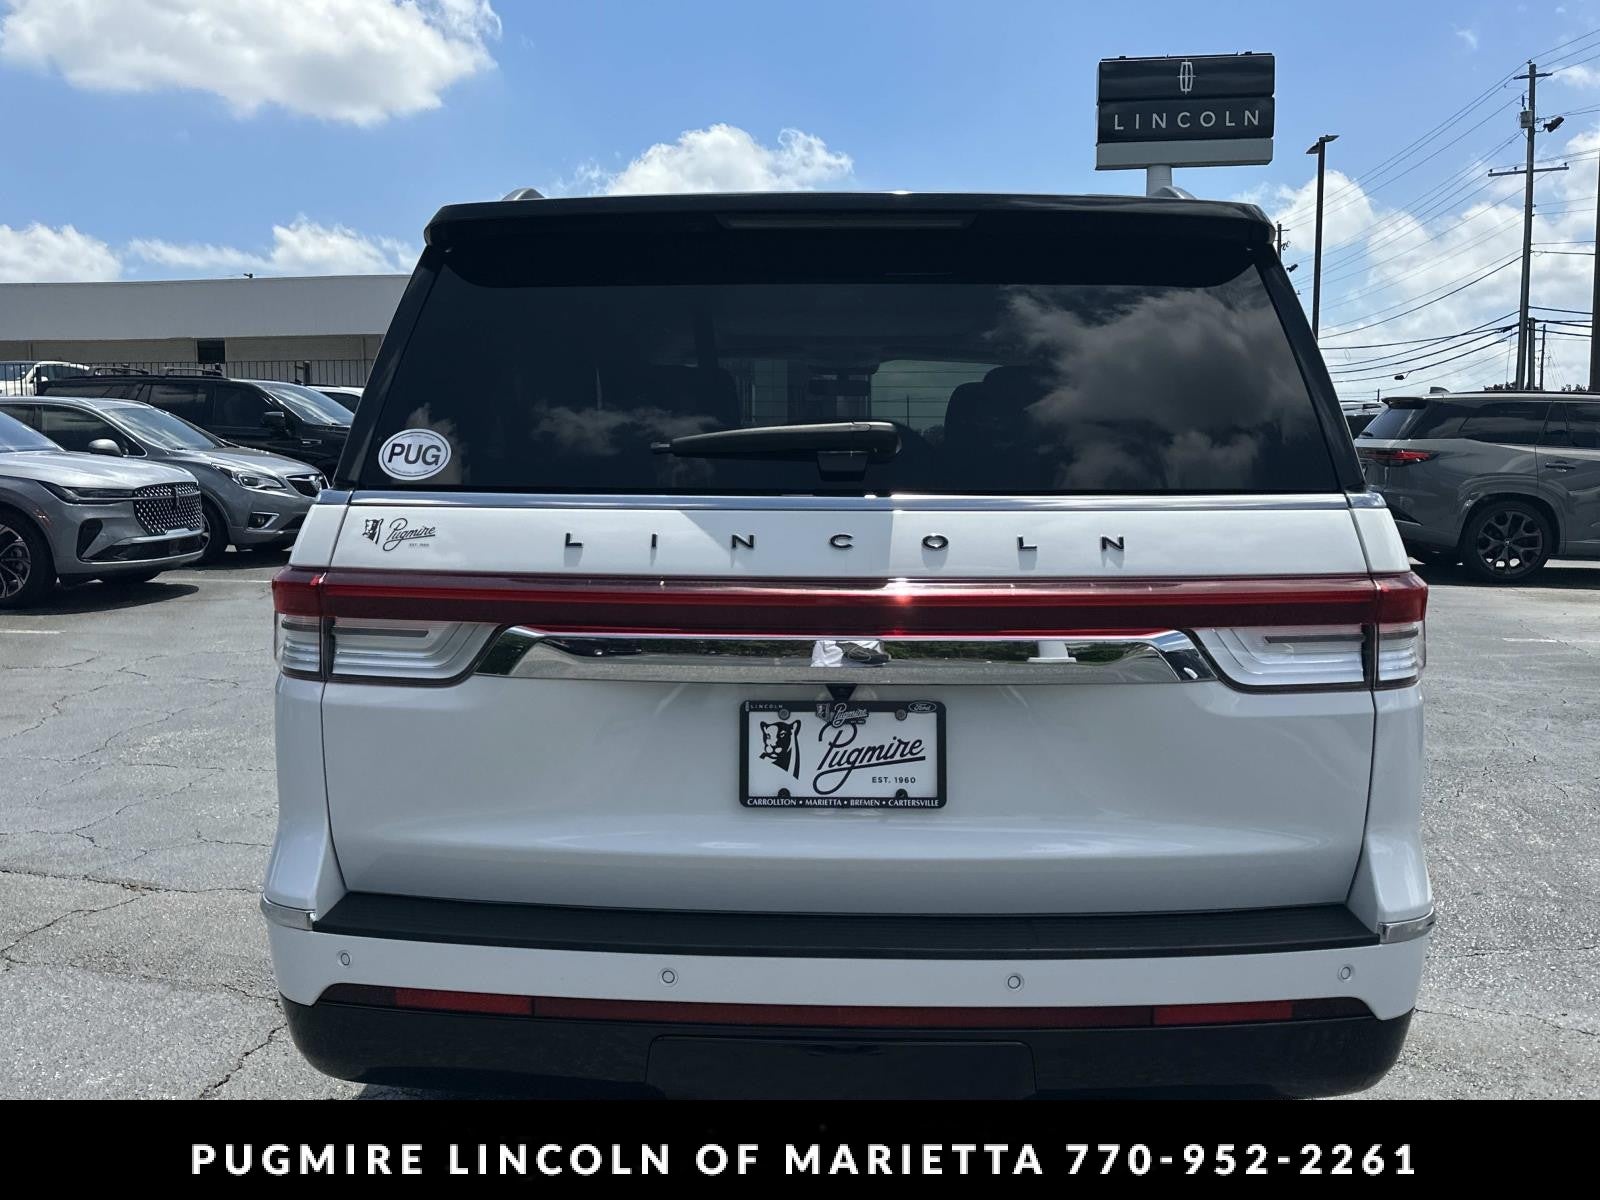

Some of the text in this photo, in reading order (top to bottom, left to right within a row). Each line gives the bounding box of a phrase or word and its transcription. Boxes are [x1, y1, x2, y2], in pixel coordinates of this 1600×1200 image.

[1114, 110, 1260, 130] LINCOLN
[387, 443, 442, 466] PUG
[383, 517, 436, 551] Pugmire
[564, 531, 1126, 553] LINCOLN
[812, 721, 926, 795] Pugmire
[871, 776, 916, 784] EST. 1960
[747, 799, 939, 807] CARROLLTON MARIETTA BREMEN CARTERSVILLE
